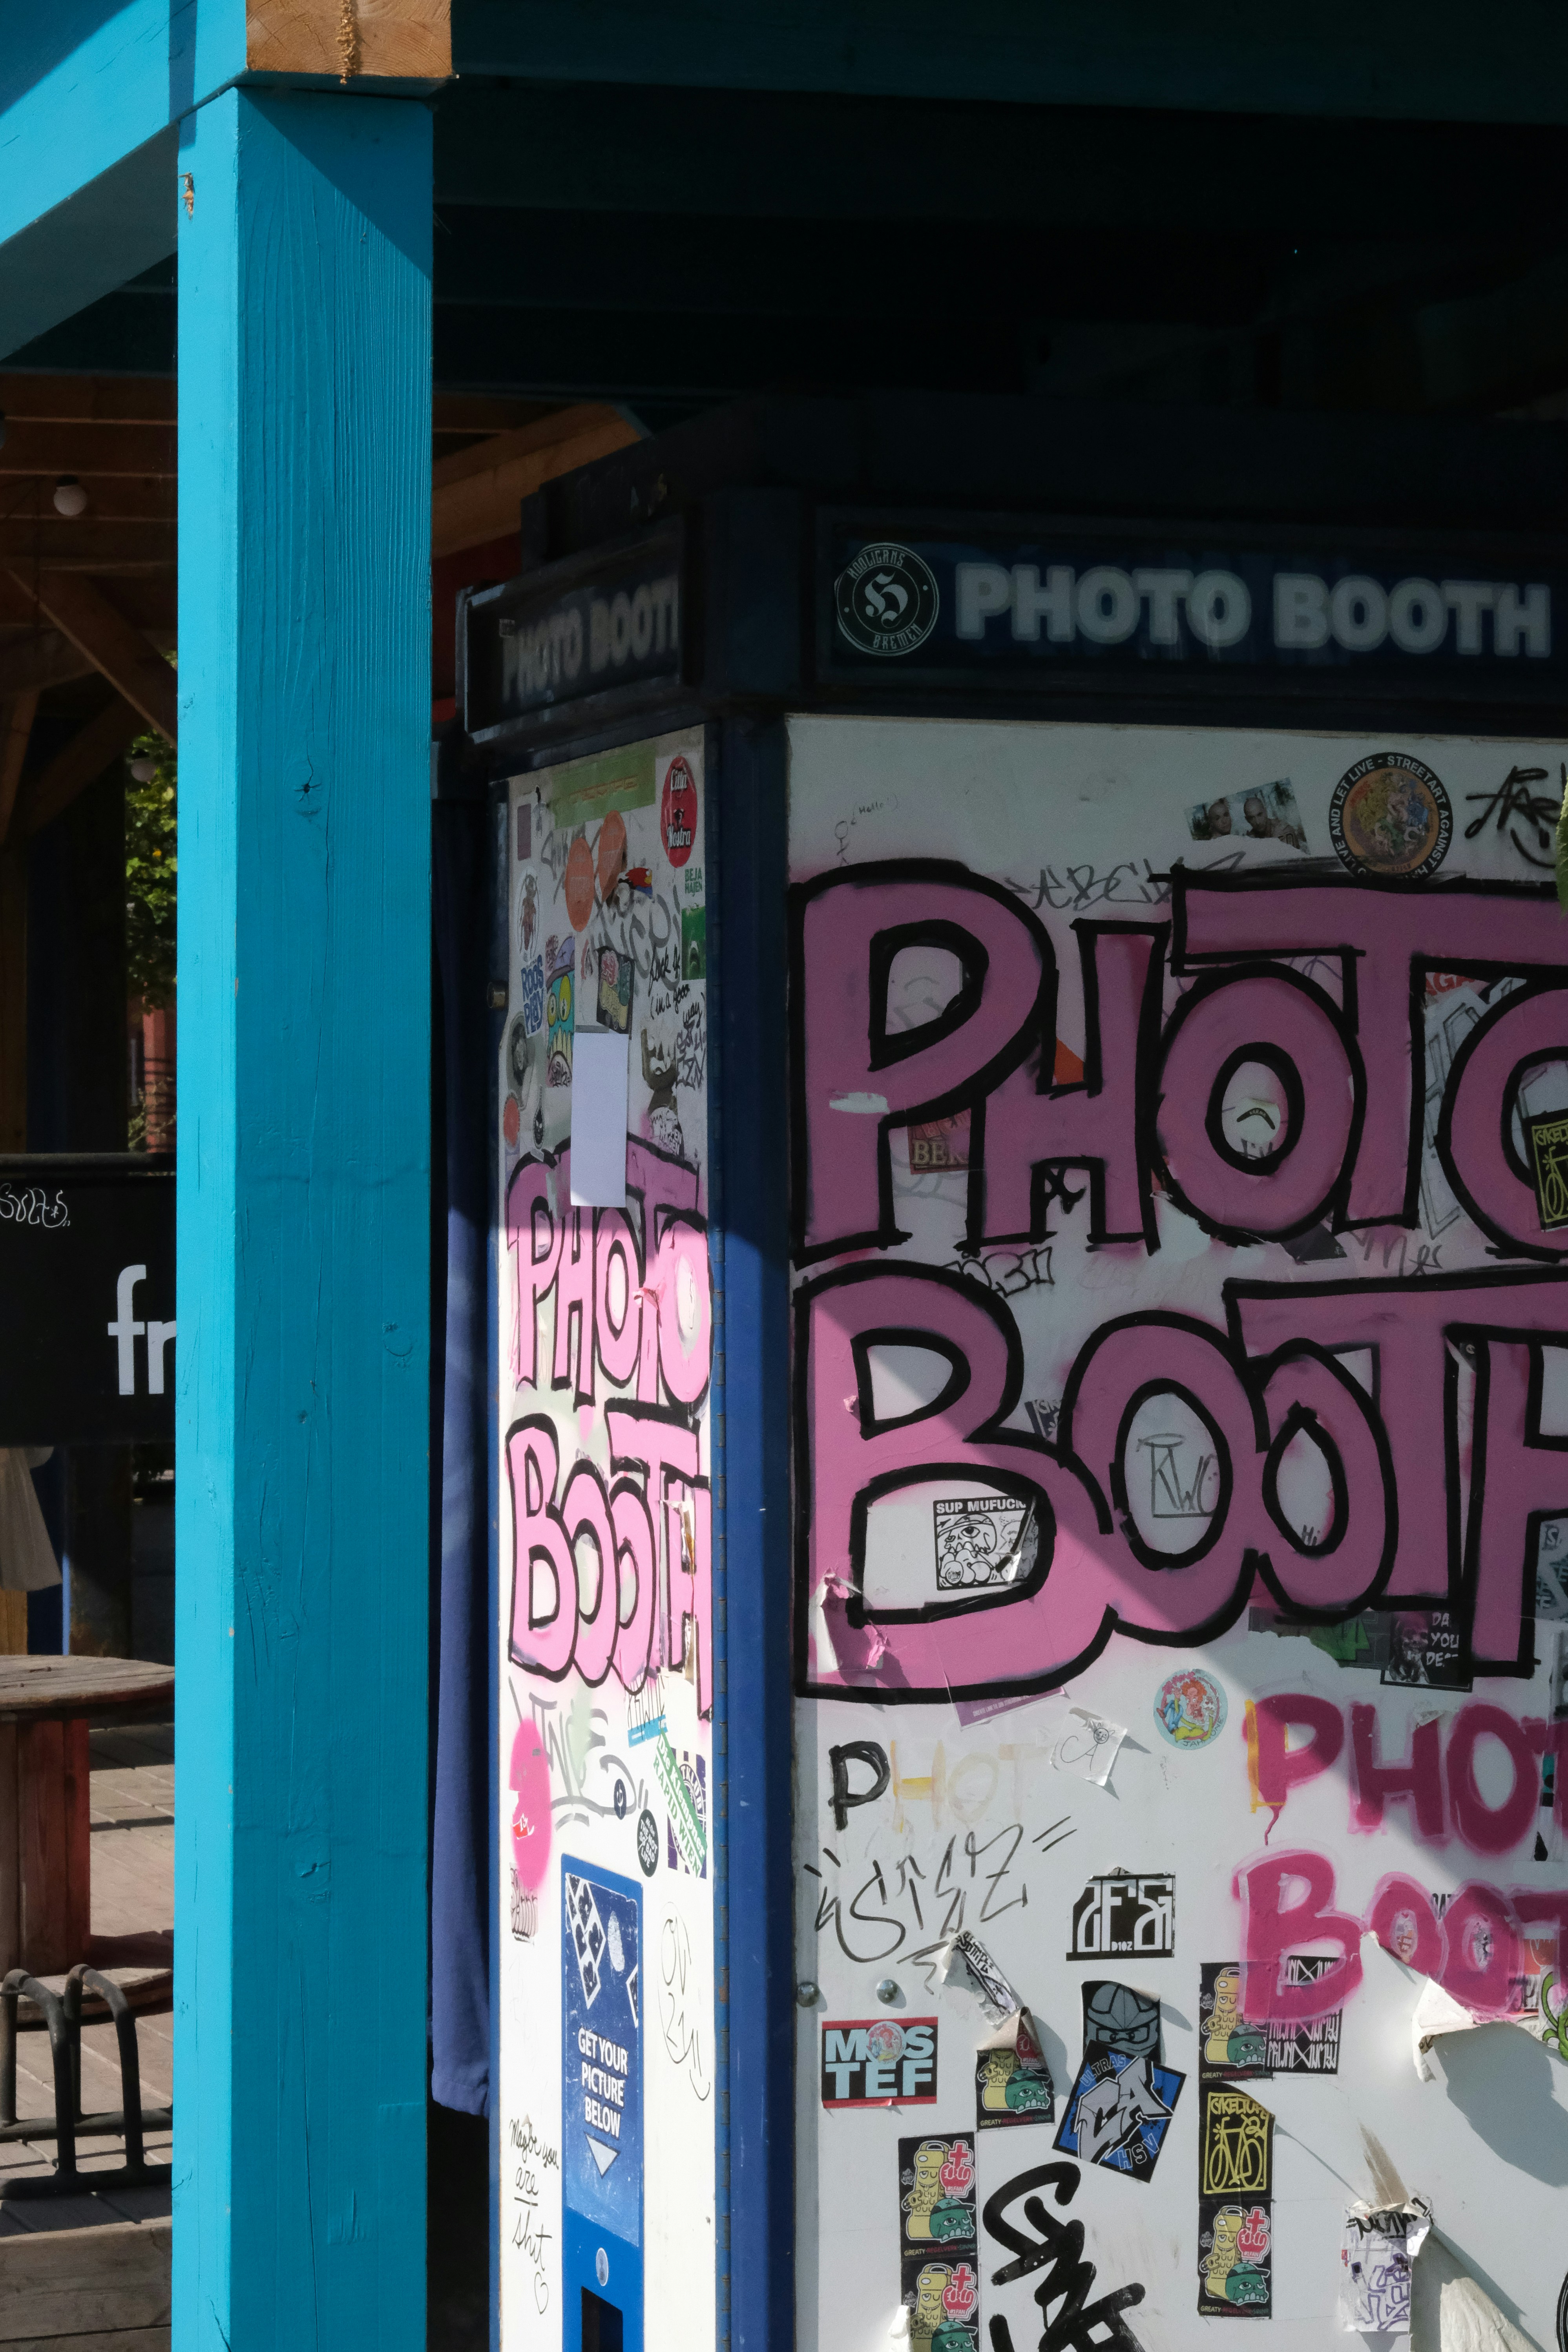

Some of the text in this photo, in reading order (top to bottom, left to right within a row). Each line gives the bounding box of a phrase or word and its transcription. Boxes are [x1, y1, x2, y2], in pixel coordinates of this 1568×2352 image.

[847, 549, 905, 579] HOOLIGANS
[955, 563, 1551, 658] PHOTO BOOTH
[873, 623, 923, 650] BREMEN
[502, 607, 584, 704] PHOTO
[1348, 758, 1375, 781] LIVE
[1387, 755, 1446, 804] STREETART
[1333, 780, 1350, 805] LET
[1331, 808, 1342, 836] AND
[1431, 809, 1450, 868] AGAINST
[936, 1502, 963, 1514] SUP
[1431, 1632, 1459, 1648] YOU
[658, 1735, 670, 1771] Die
[653, 1754, 677, 1820] RAPID
[679, 1819, 701, 1878] WIEN
[578, 2027, 628, 2076] GET YOUR
[825, 2025, 934, 2062] MS
[582, 2061, 626, 2107] PICTURE
[825, 2059, 933, 2099] TEF
[1080, 2054, 1126, 2087] ULTRAS
[585, 2095, 621, 2138] BELOW
[542, 2142, 559, 2170] you
[1117, 2133, 1159, 2170] HSV
[515, 2166, 539, 2196] are
[512, 2209, 553, 2272] shit
